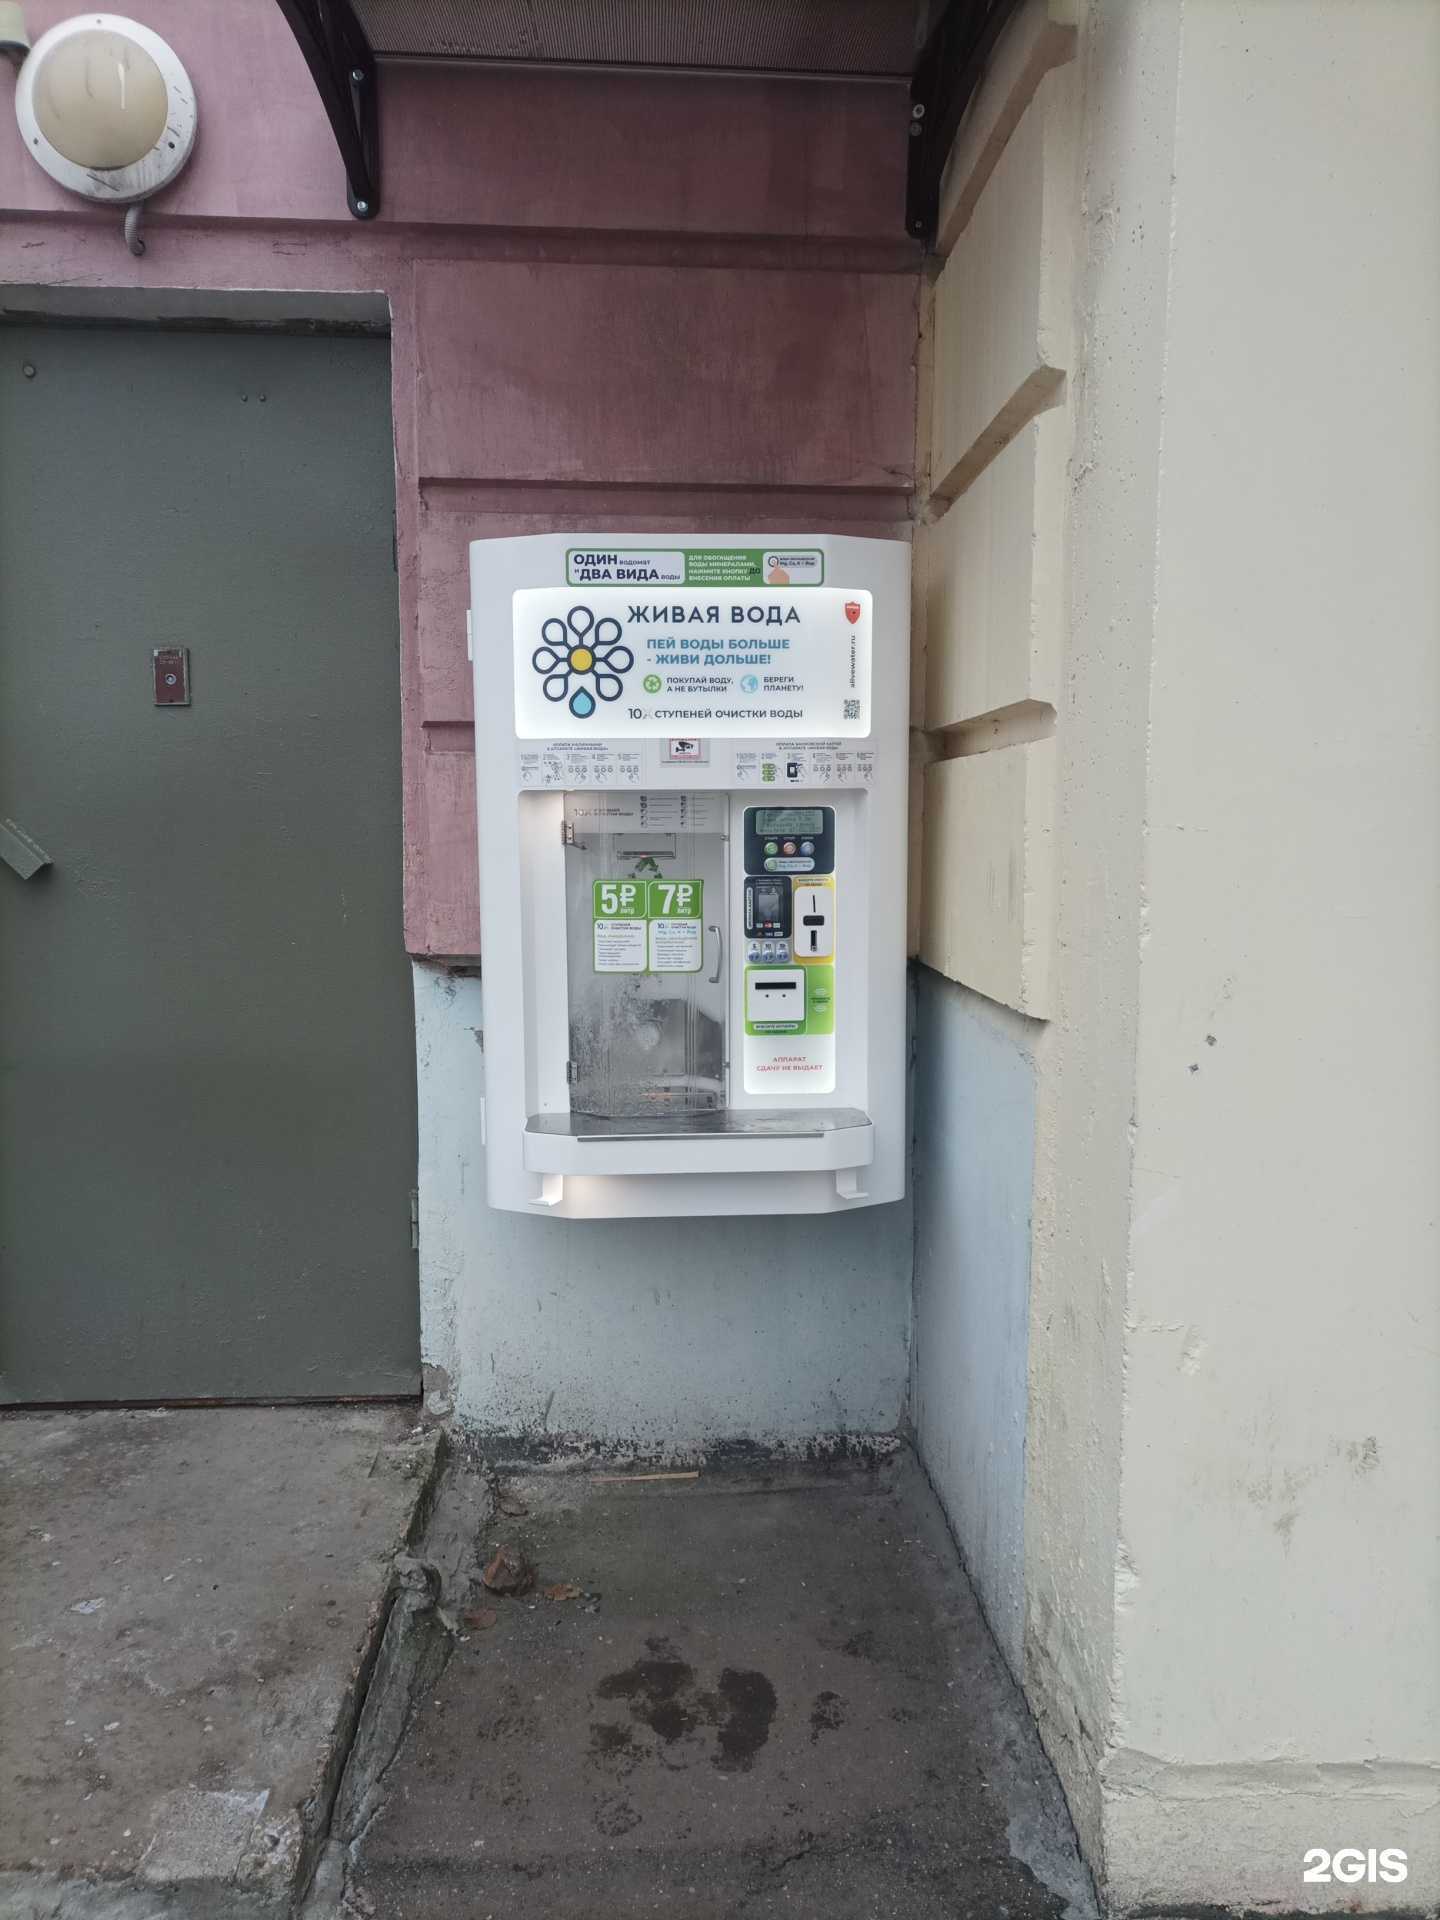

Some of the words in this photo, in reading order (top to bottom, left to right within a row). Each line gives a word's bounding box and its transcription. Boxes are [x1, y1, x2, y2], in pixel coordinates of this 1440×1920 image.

[574, 554, 618, 566] ОДИН
[580, 569, 612, 581] ДВА
[617, 569, 660, 581] ВИДА
[627, 606, 720, 623] ЖИВАЯ
[731, 606, 801, 626] ВОДА
[647, 637, 676, 649] ПЕЙ
[680, 639, 724, 651] ВОДЫ
[729, 639, 790, 649] БОЛЬШЕ
[656, 654, 700, 665] ЖИВИ
[704, 654, 771, 667] ДОЛЬШЕ!
[667, 676, 707, 684] ПОКУПАЙ
[709, 677, 734, 685] ВОДУ,
[655, 707, 712, 719] СТУПЕНЕЙ
[715, 710, 767, 719] ОЧИСТКИ
[770, 710, 803, 720] ВОДЫ
